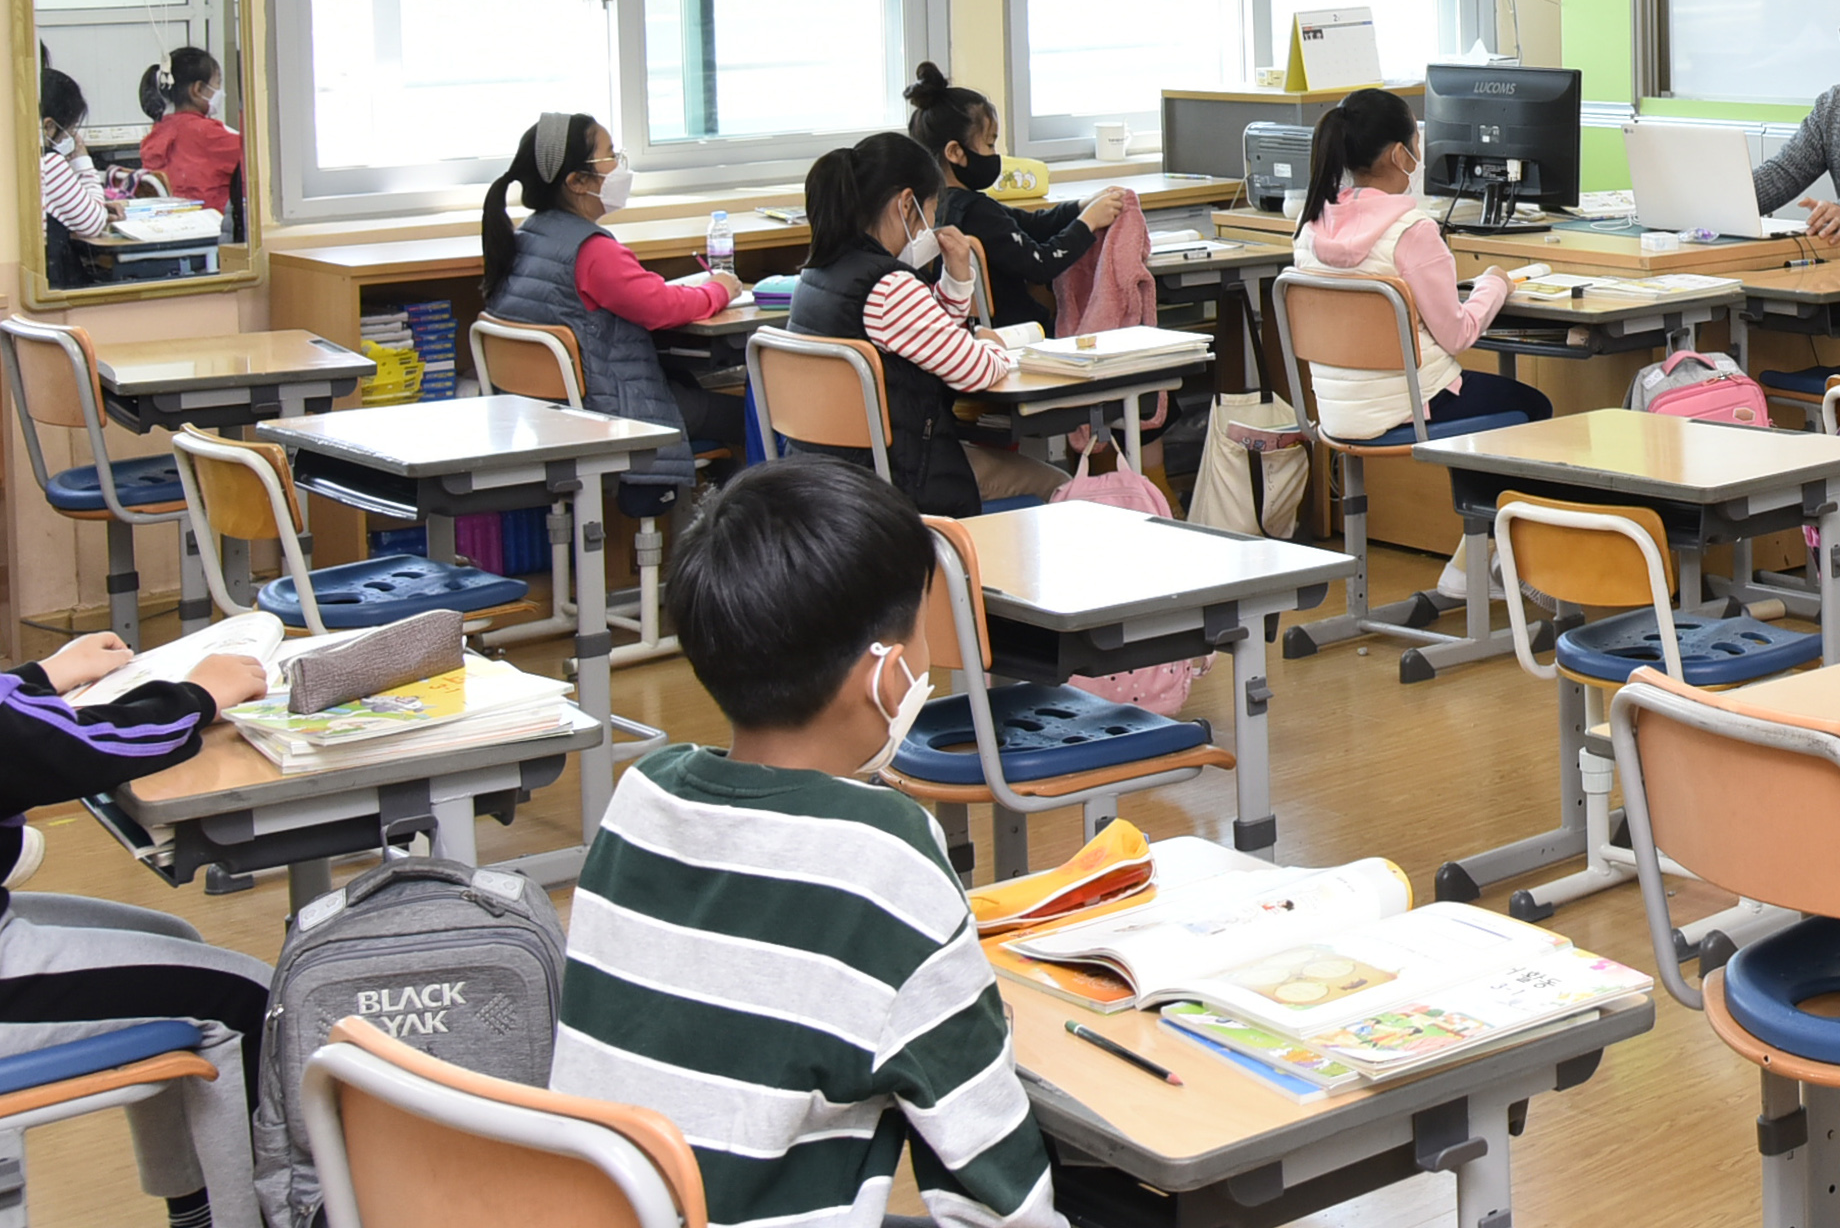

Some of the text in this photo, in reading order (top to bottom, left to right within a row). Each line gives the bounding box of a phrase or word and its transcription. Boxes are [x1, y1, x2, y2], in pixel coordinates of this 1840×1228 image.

[1473, 81, 1517, 95] LUCOMS
[357, 981, 467, 1014] BLACK
[381, 1010, 449, 1038] YAK
